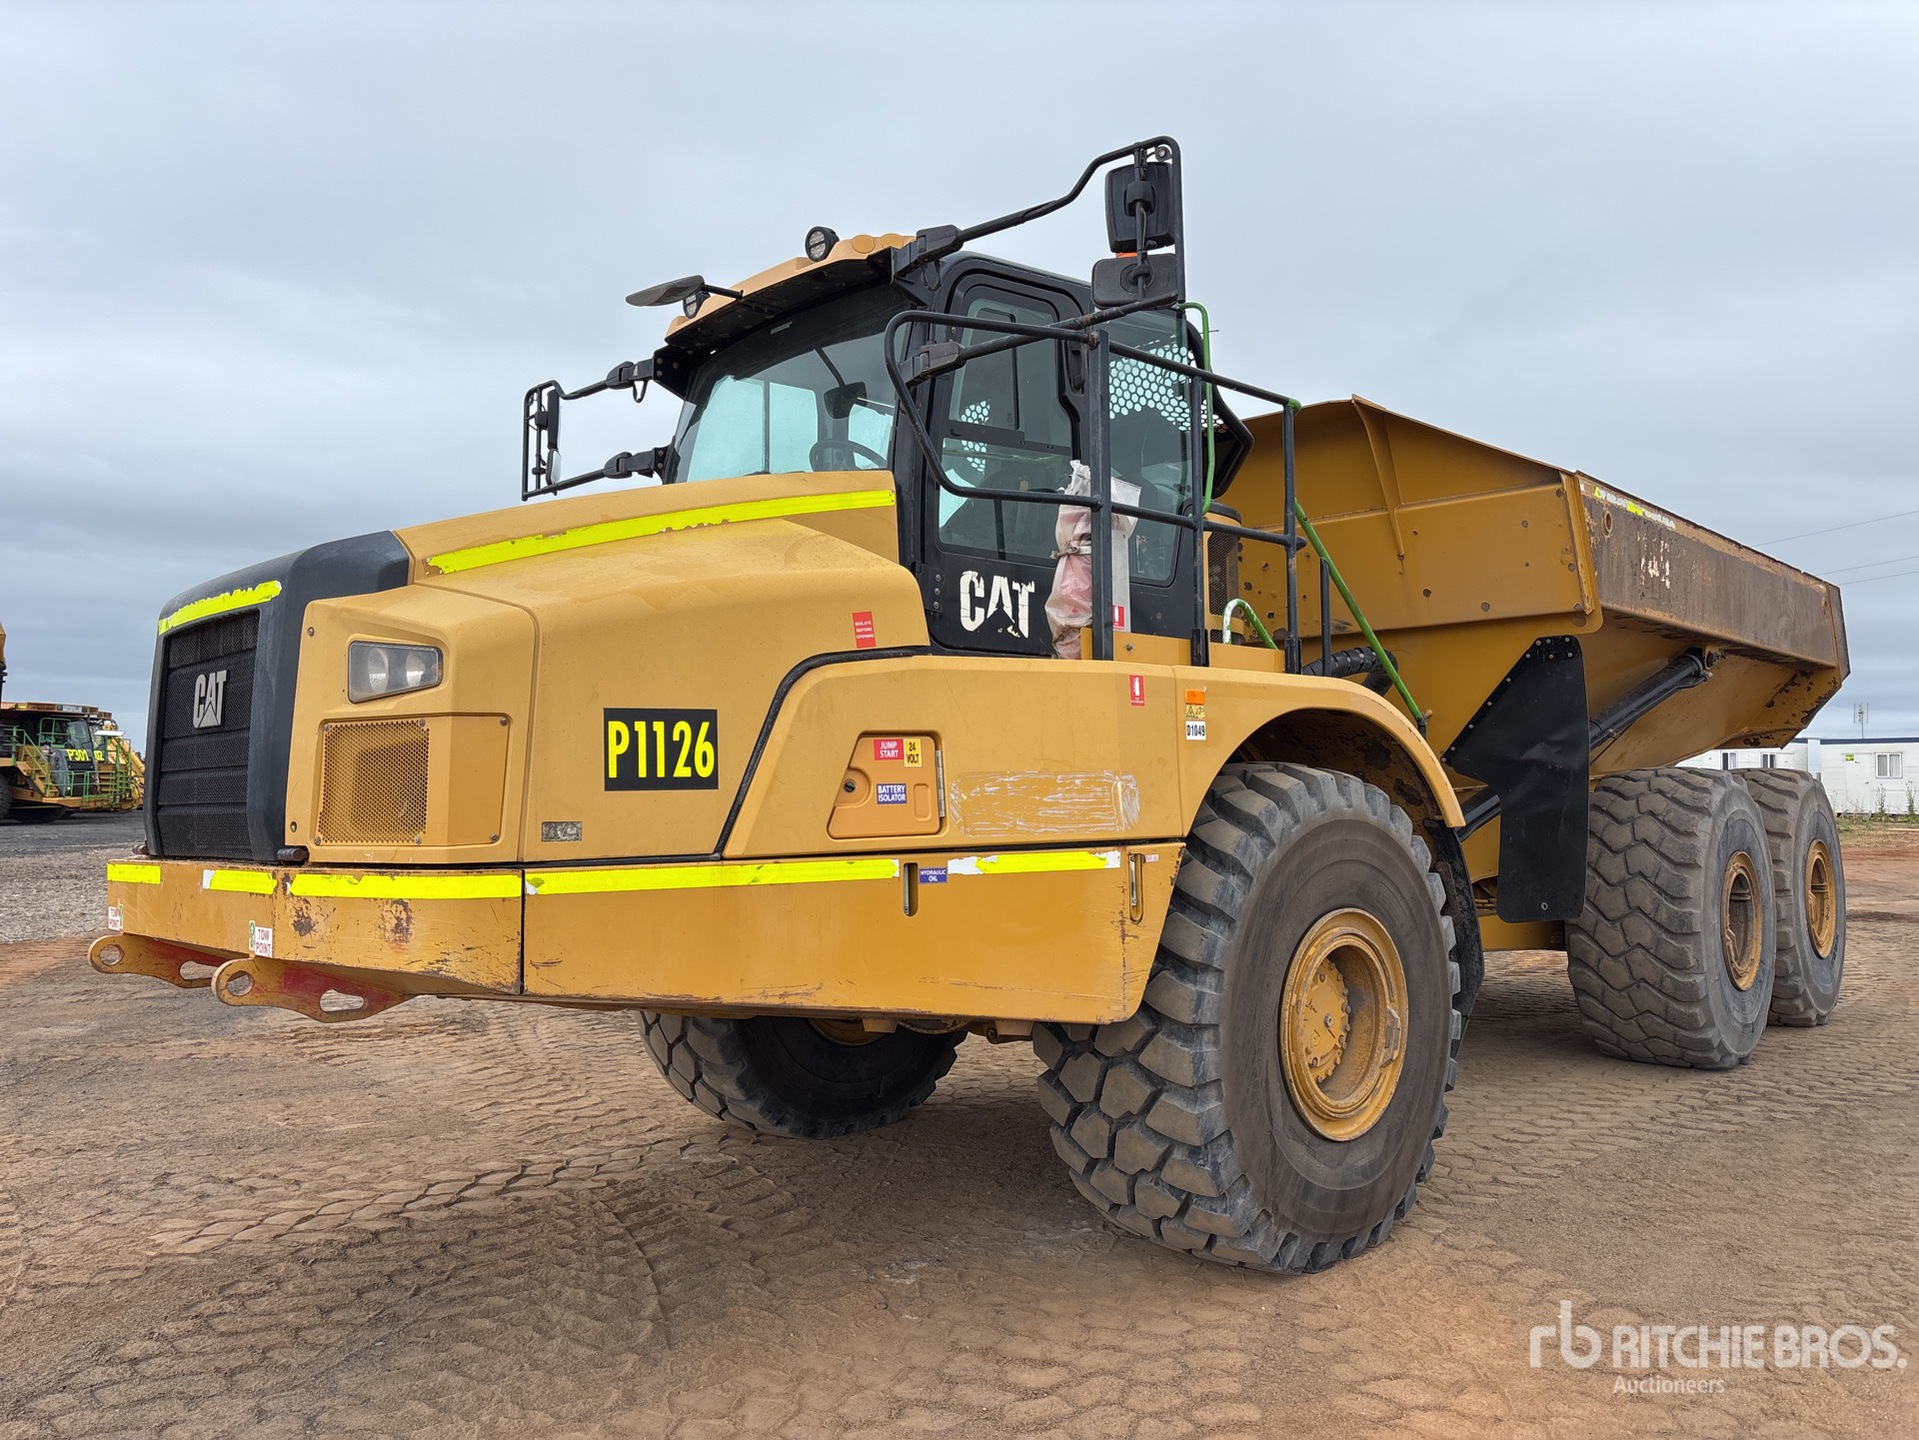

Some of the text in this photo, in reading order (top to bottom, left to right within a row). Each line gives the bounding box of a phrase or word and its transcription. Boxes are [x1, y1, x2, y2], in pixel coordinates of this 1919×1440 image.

[960, 570, 1035, 639] CAT
[193, 669, 227, 729] CAT
[607, 720, 715, 778] P1126
[880, 741, 897, 750] JUMP
[908, 741, 916, 752] 24
[66, 749, 89, 761] P301
[879, 749, 899, 759] START
[906, 753, 919, 764] VOLT
[877, 784, 905, 794] BATTERY
[878, 793, 906, 802] ISOLATOR
[257, 928, 270, 940] TOW
[255, 941, 271, 957] POINT
